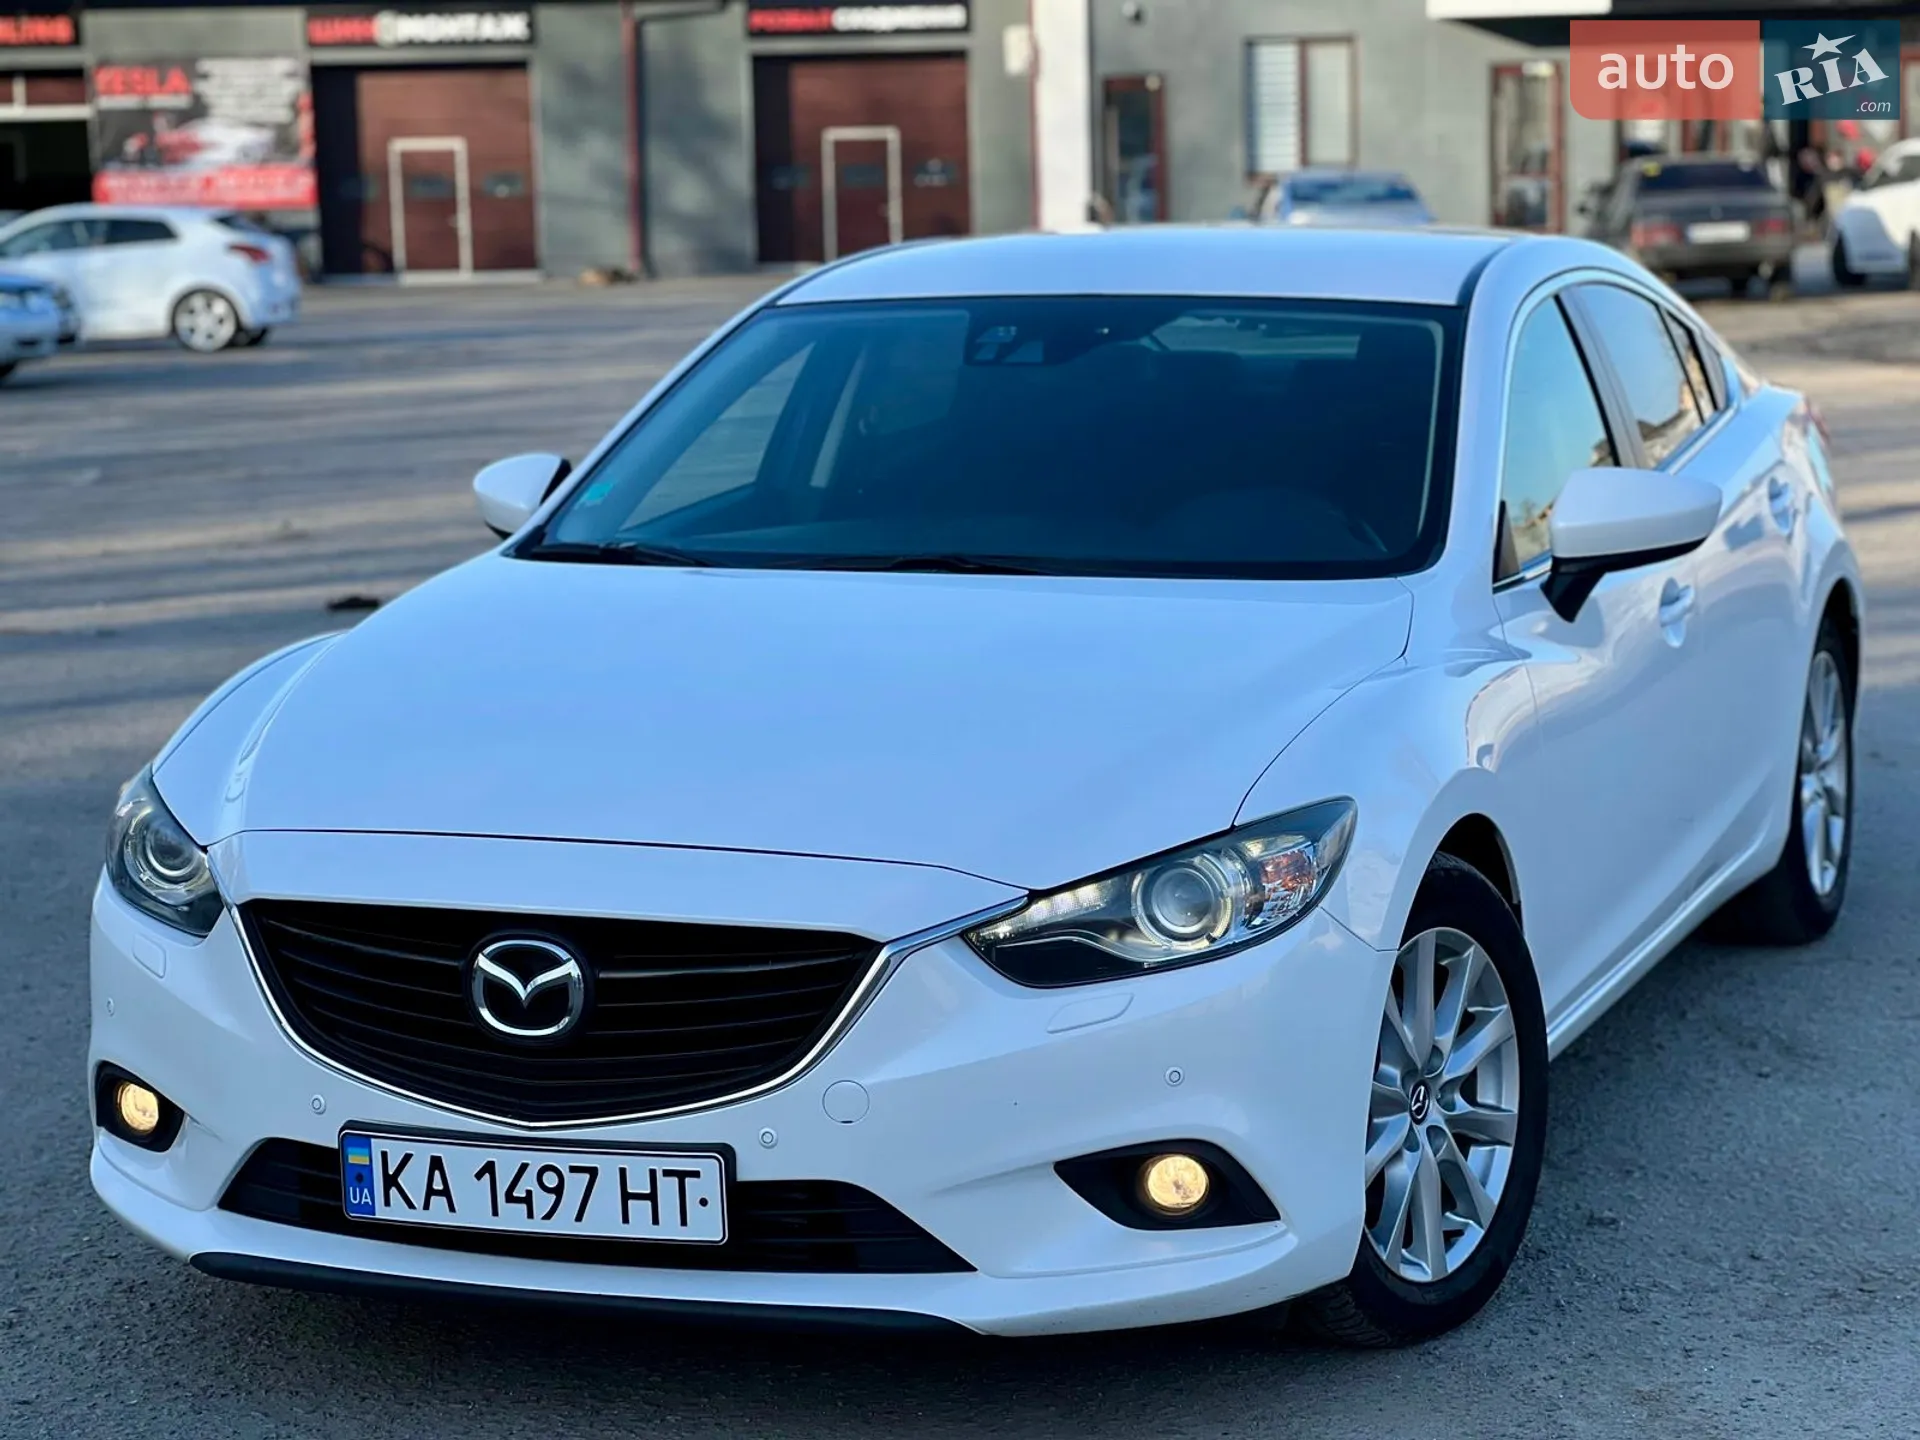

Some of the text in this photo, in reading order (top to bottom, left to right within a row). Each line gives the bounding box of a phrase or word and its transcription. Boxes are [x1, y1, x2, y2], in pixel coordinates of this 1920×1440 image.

[94, 65, 191, 95] TESLA
[350, 1186, 372, 1205] UA
[379, 1150, 701, 1226] KA 1497 HT
